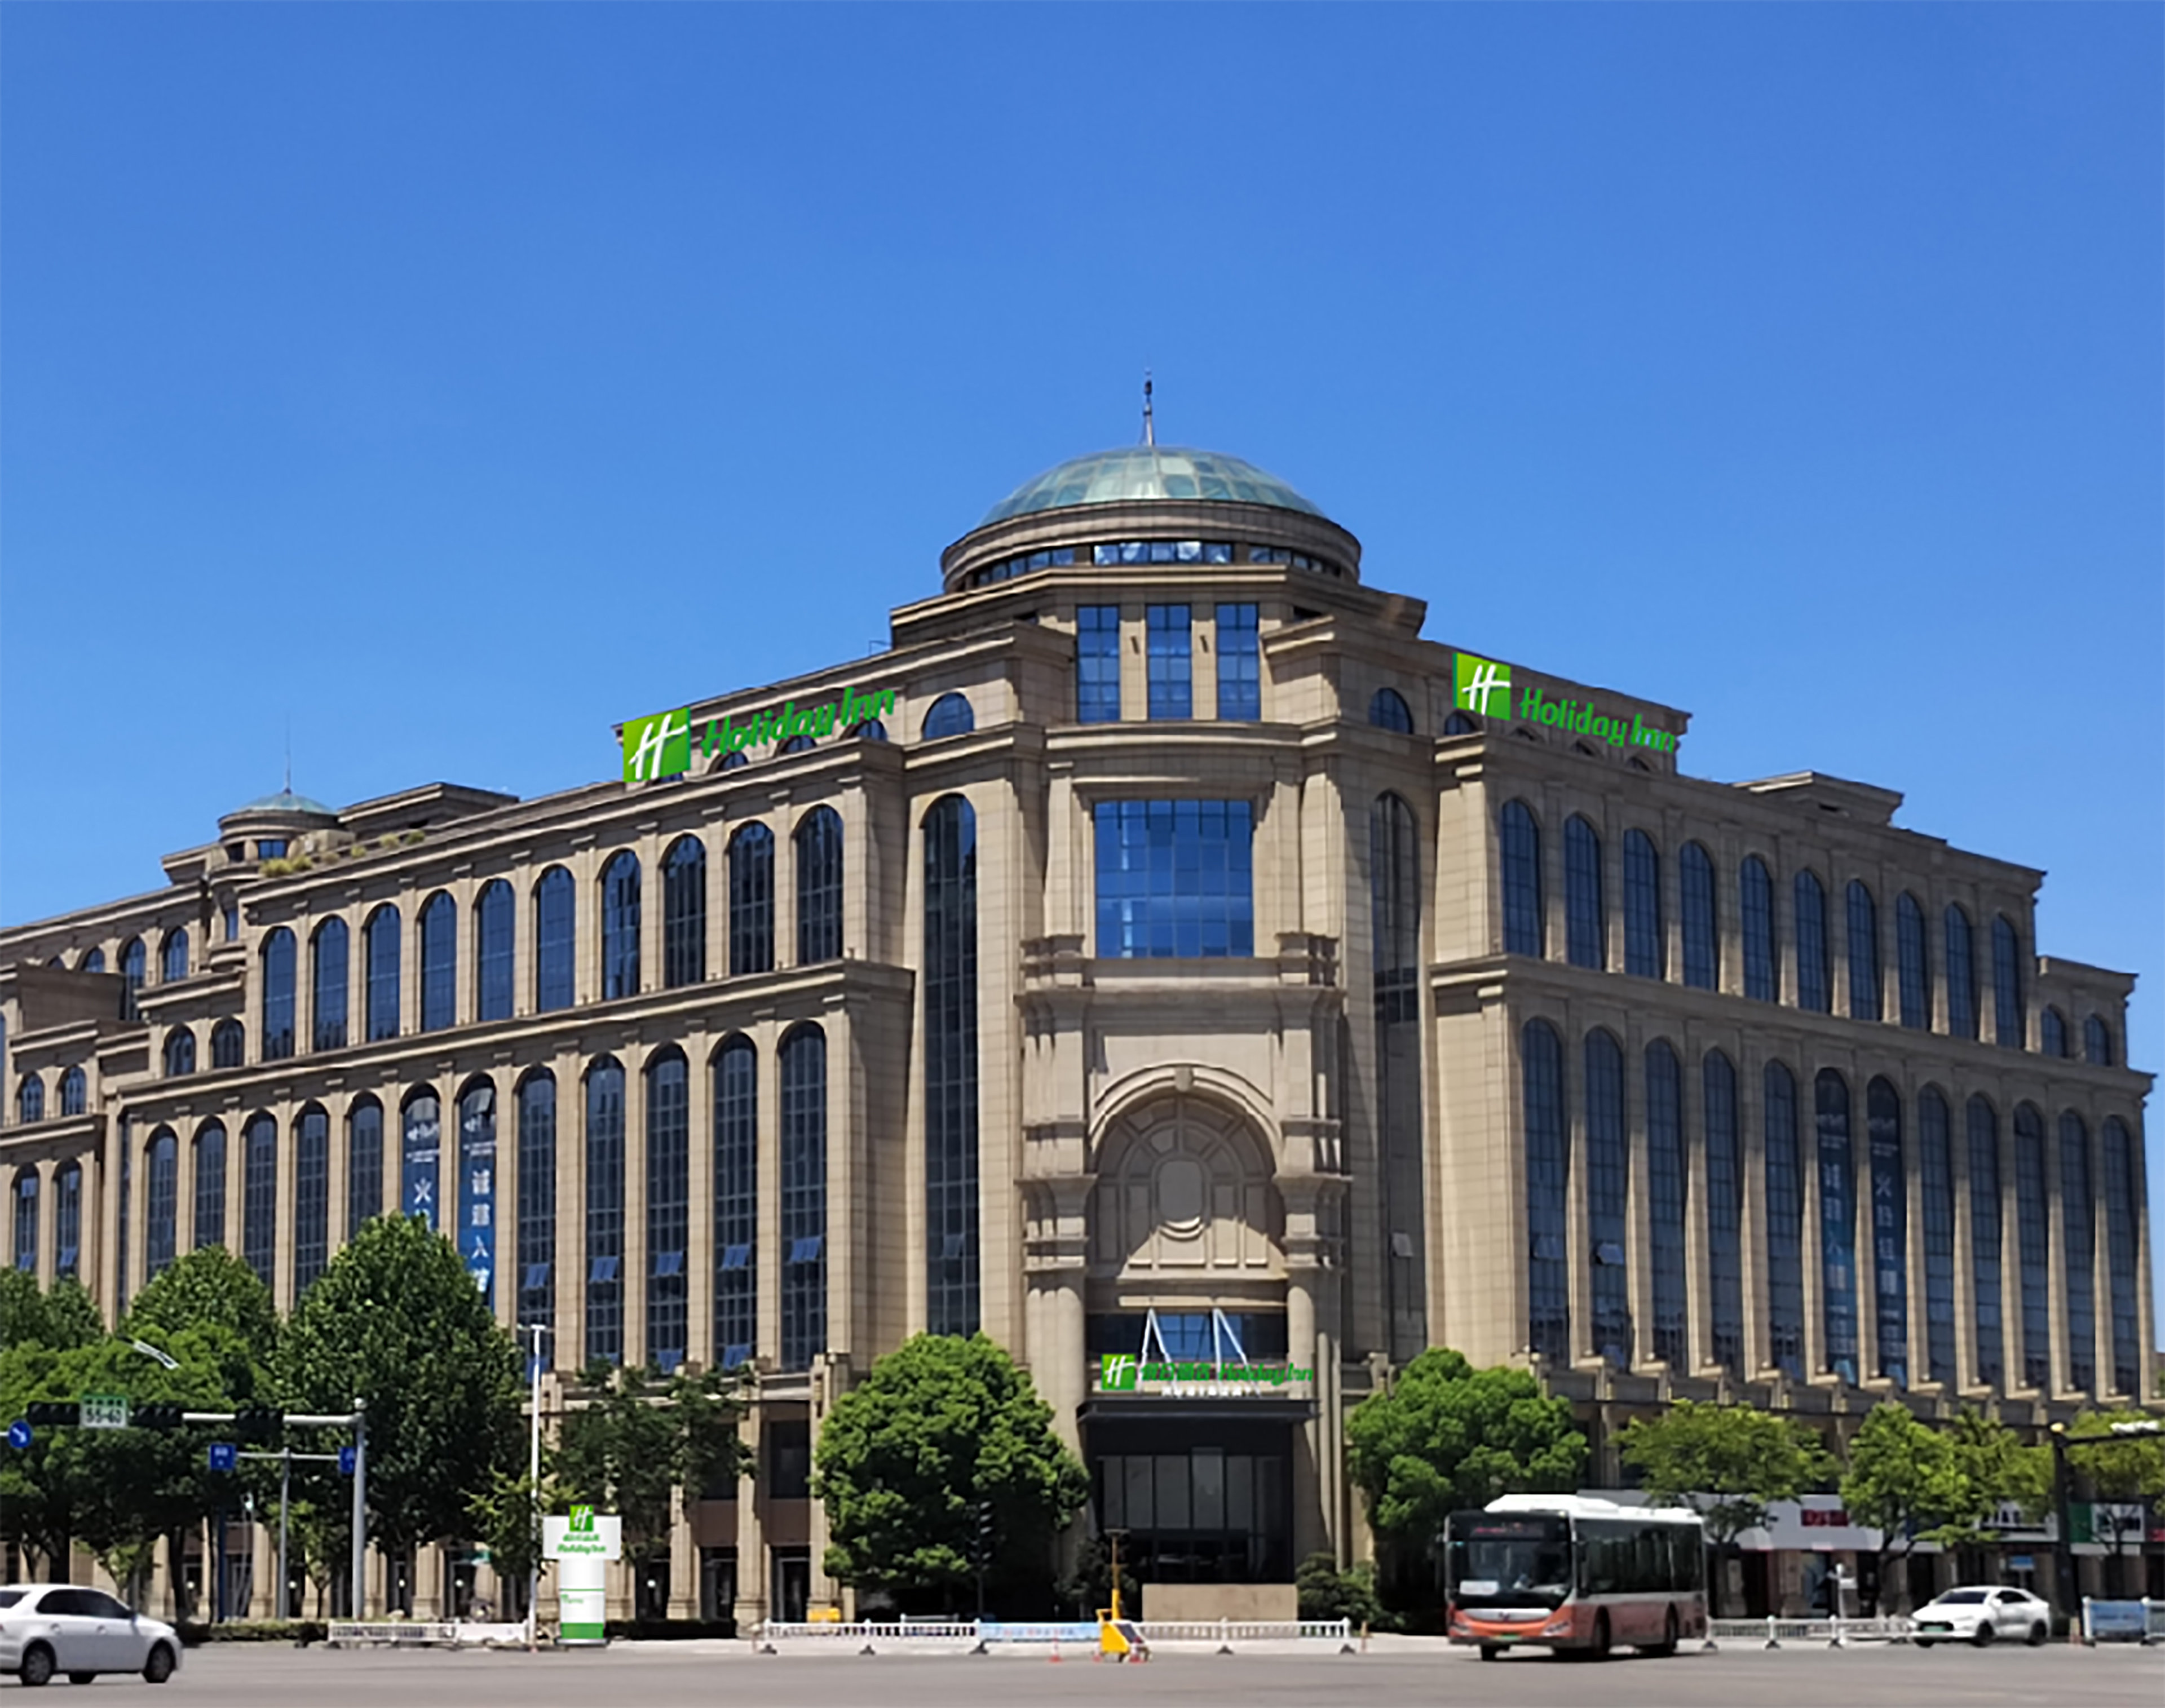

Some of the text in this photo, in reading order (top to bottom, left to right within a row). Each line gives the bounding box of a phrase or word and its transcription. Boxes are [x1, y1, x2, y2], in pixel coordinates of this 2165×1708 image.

[700, 702, 836, 758] Holiday
[841, 686, 895, 726] Inn
[1519, 687, 1628, 747] Holiday
[1631, 713, 1676, 753] Inn
[1218, 1362, 1285, 1386] Holiday
